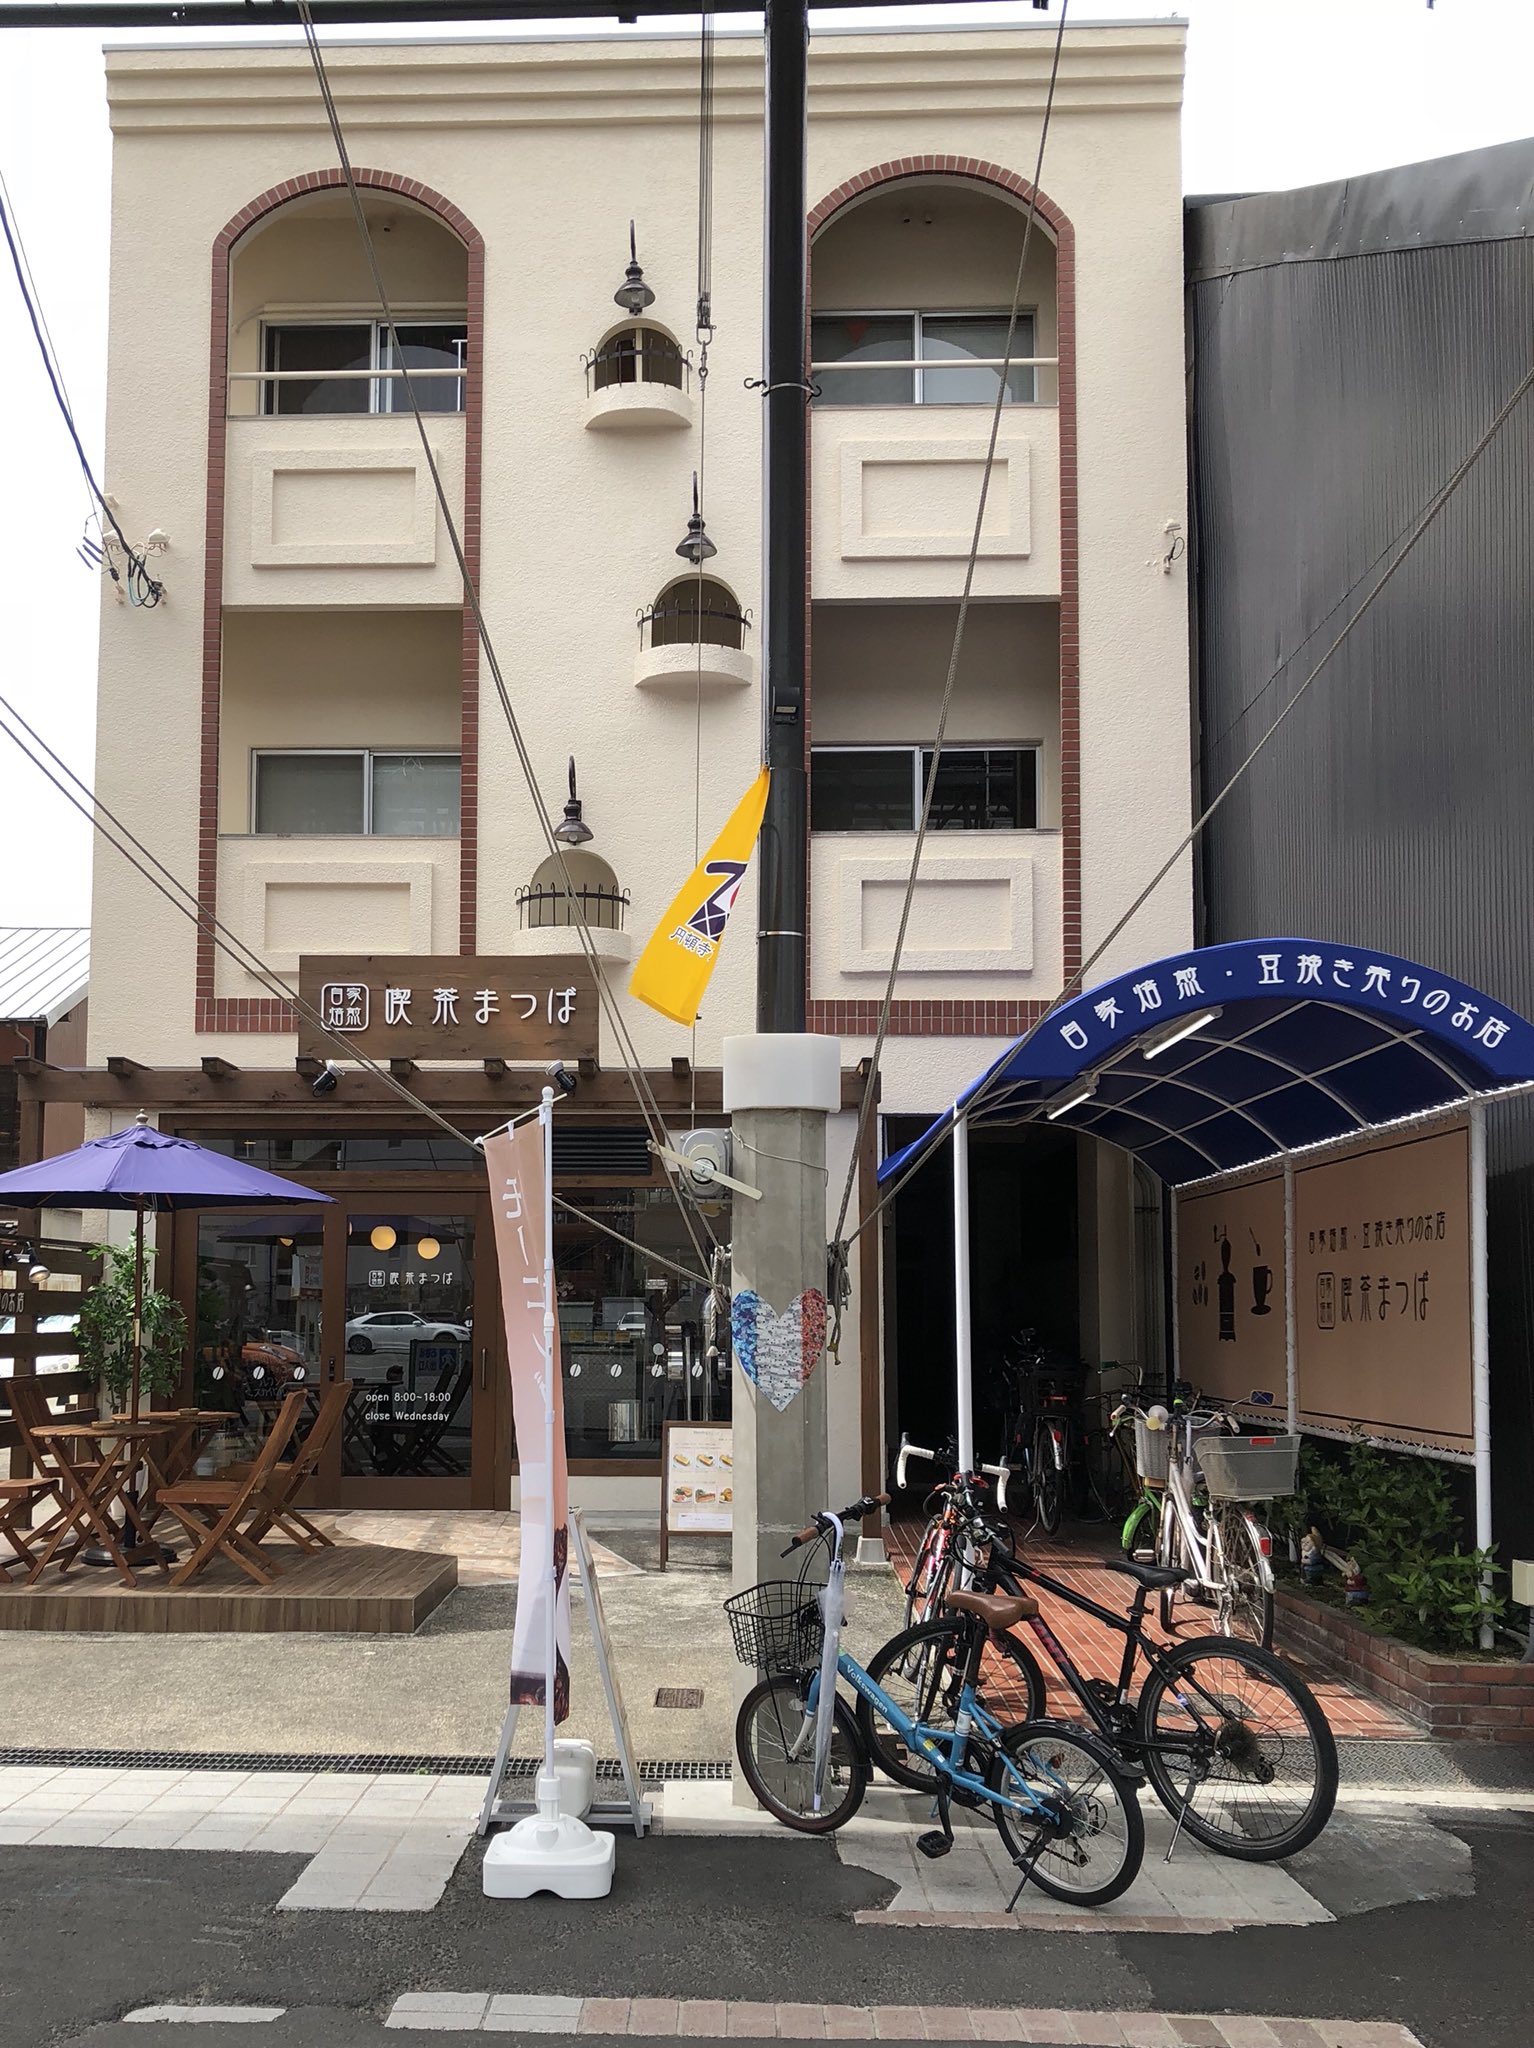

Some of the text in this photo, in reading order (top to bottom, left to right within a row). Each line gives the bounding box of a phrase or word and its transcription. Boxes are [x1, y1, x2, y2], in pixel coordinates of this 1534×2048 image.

[385, 986, 577, 1026] 喫茶まつば
[365, 1394, 390, 1403] open
[365, 1411, 450, 1422] close Wednesday
[846, 1664, 888, 1714] Volkswagen
